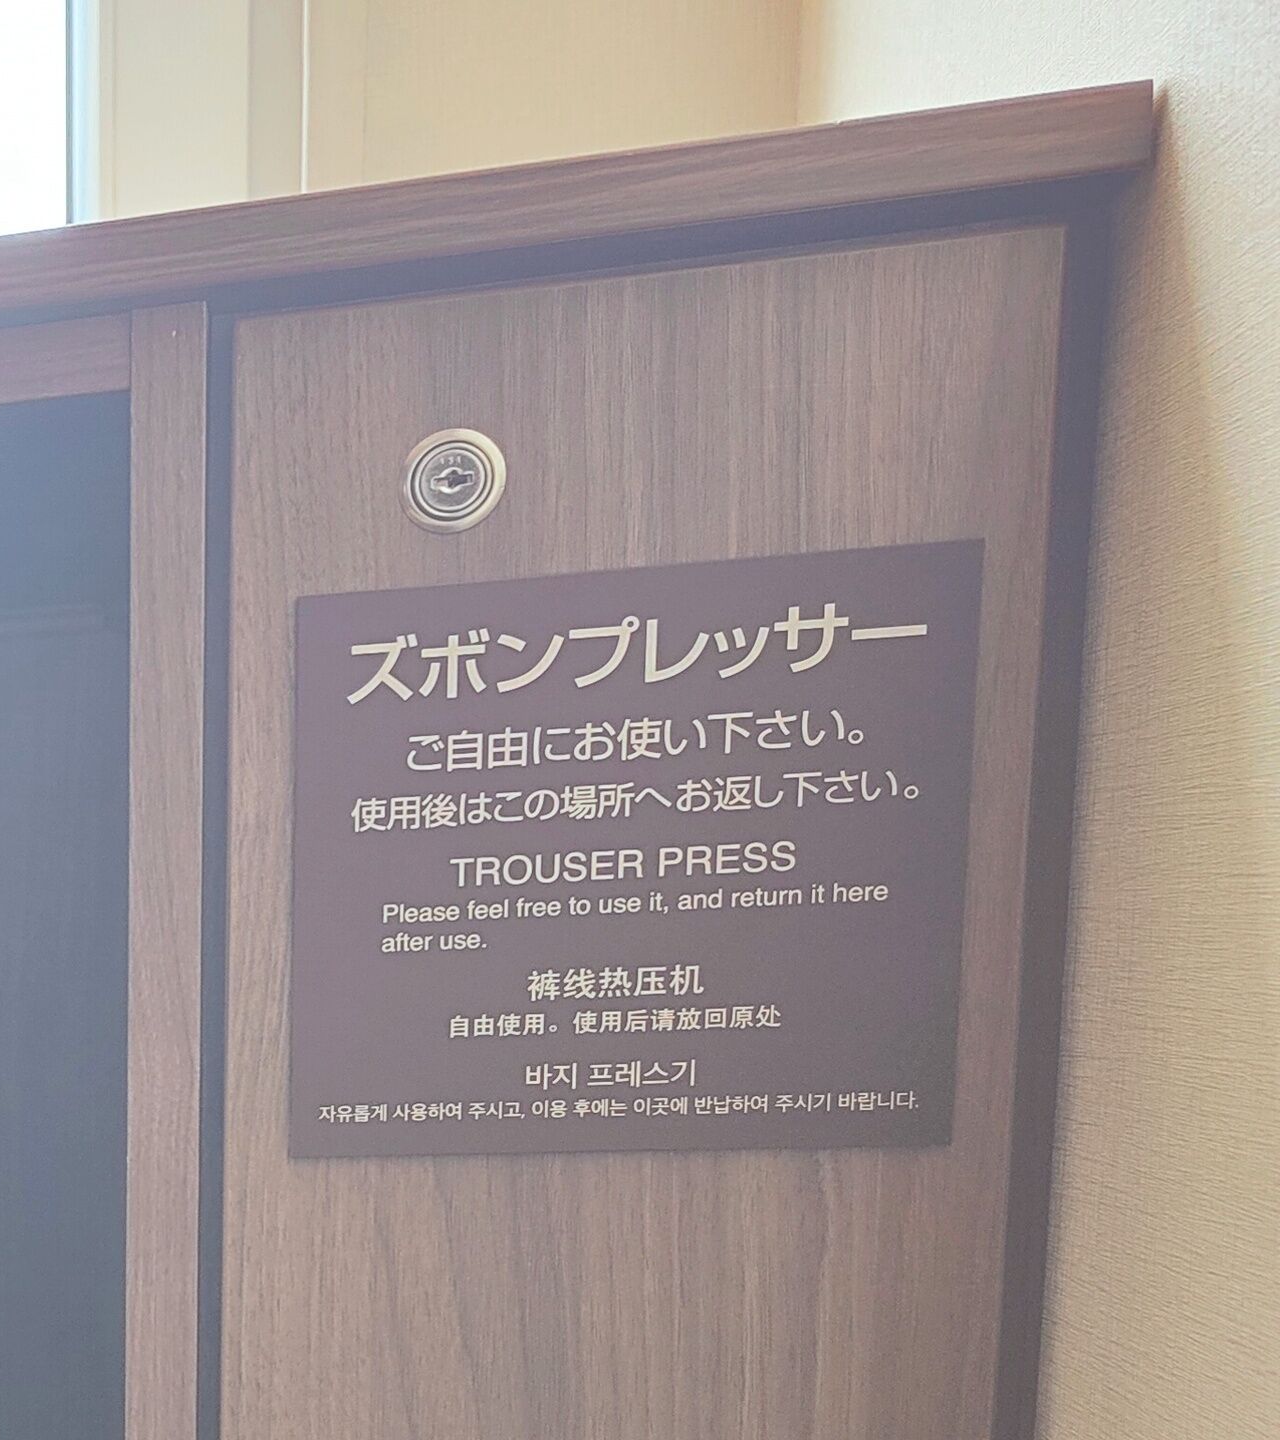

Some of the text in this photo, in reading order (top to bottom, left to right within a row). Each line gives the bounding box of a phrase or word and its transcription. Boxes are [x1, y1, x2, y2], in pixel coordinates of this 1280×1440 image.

[346, 602, 928, 705] ズボンプレッサー
[406, 709, 865, 772] ご自由にお使い下さい。
[350, 770, 920, 833] 使用後はこの場所へお返し下さい。
[449, 840, 797, 887] TROUSER PRESS
[382, 882, 889, 924] Please feel free to use it, and return it here
[381, 932, 487, 953] after use.
[527, 963, 705, 1002] 裤线热压机
[449, 1004, 782, 1039] 自由使用。使用后请放回原处
[525, 1058, 696, 1091] 바지 프레스기
[318, 1090, 919, 1123] 자유롭게 사용하여 주시고, 이용 후에는 이곳에 반납하여 주시기 바랍니다.
